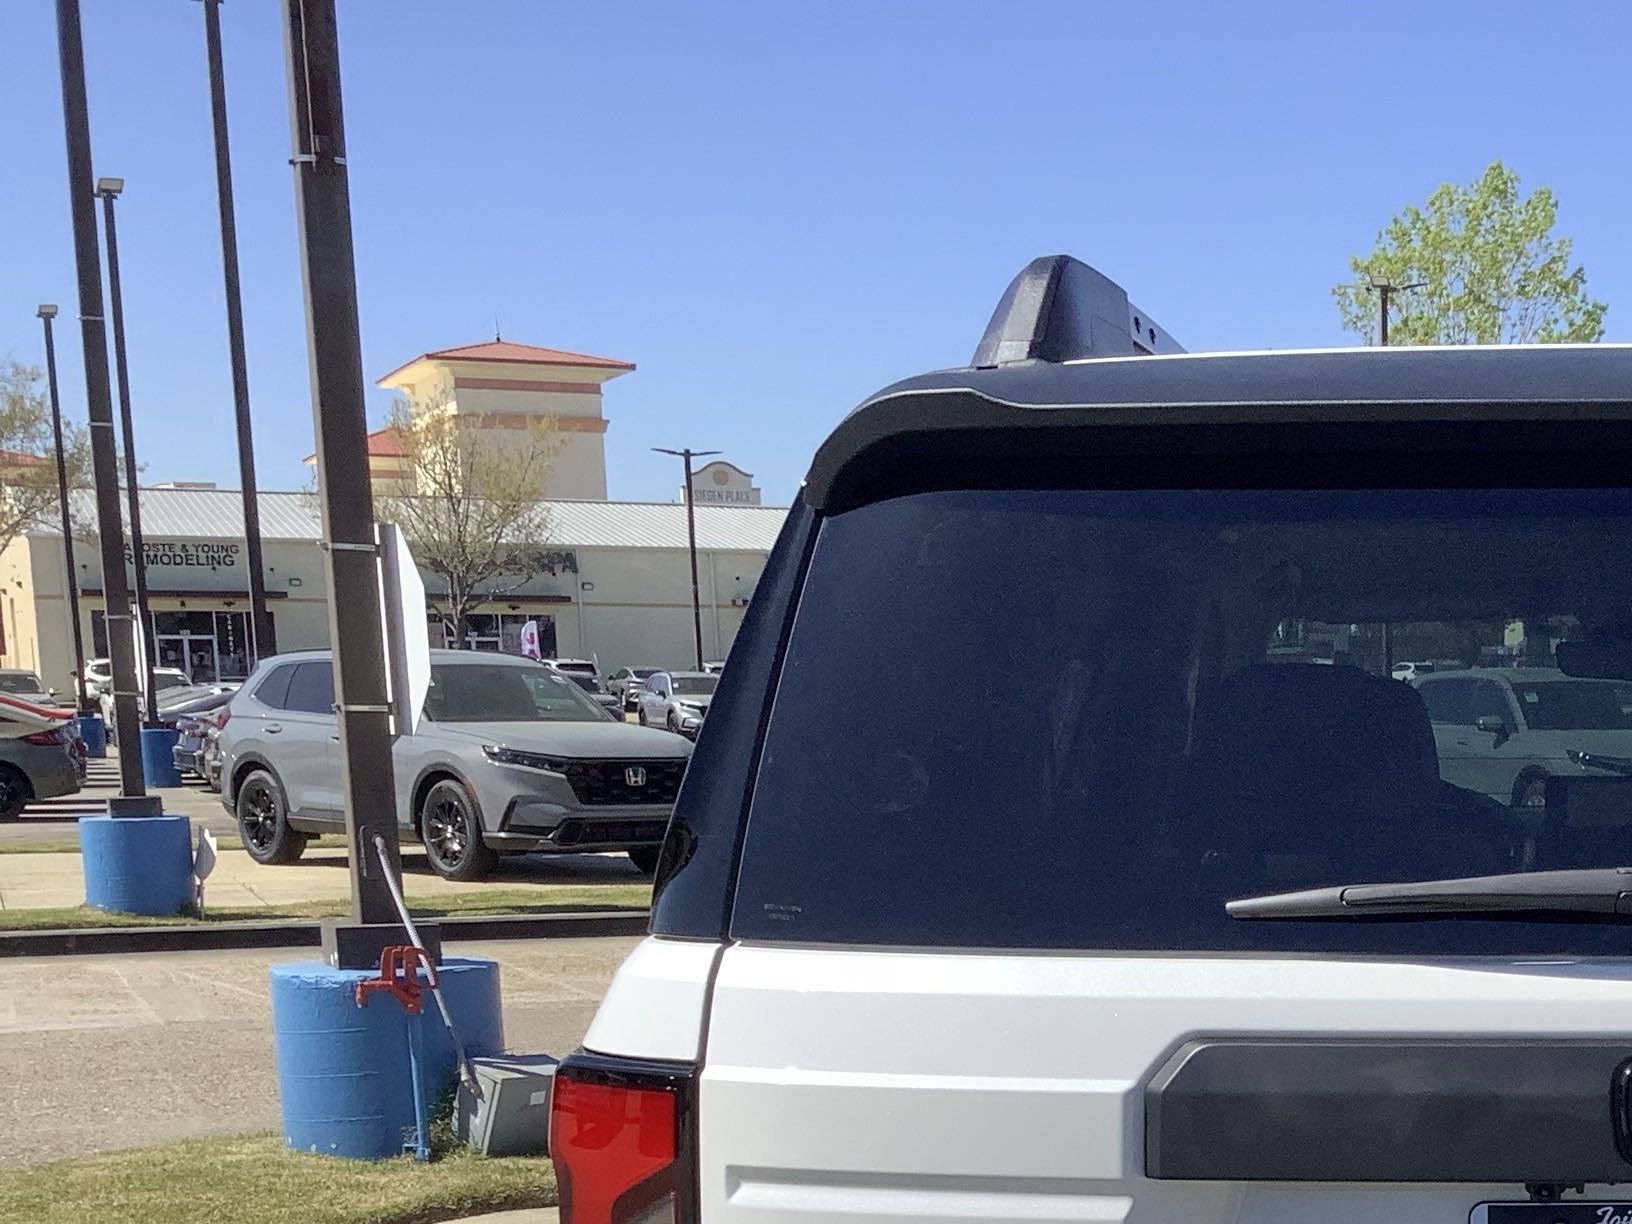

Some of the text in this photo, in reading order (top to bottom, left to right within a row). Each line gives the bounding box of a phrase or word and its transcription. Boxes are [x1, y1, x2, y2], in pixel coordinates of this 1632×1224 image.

[180, 543, 189, 553] &
[191, 543, 240, 554] YOUNG
[123, 553, 235, 567] RMODELING
